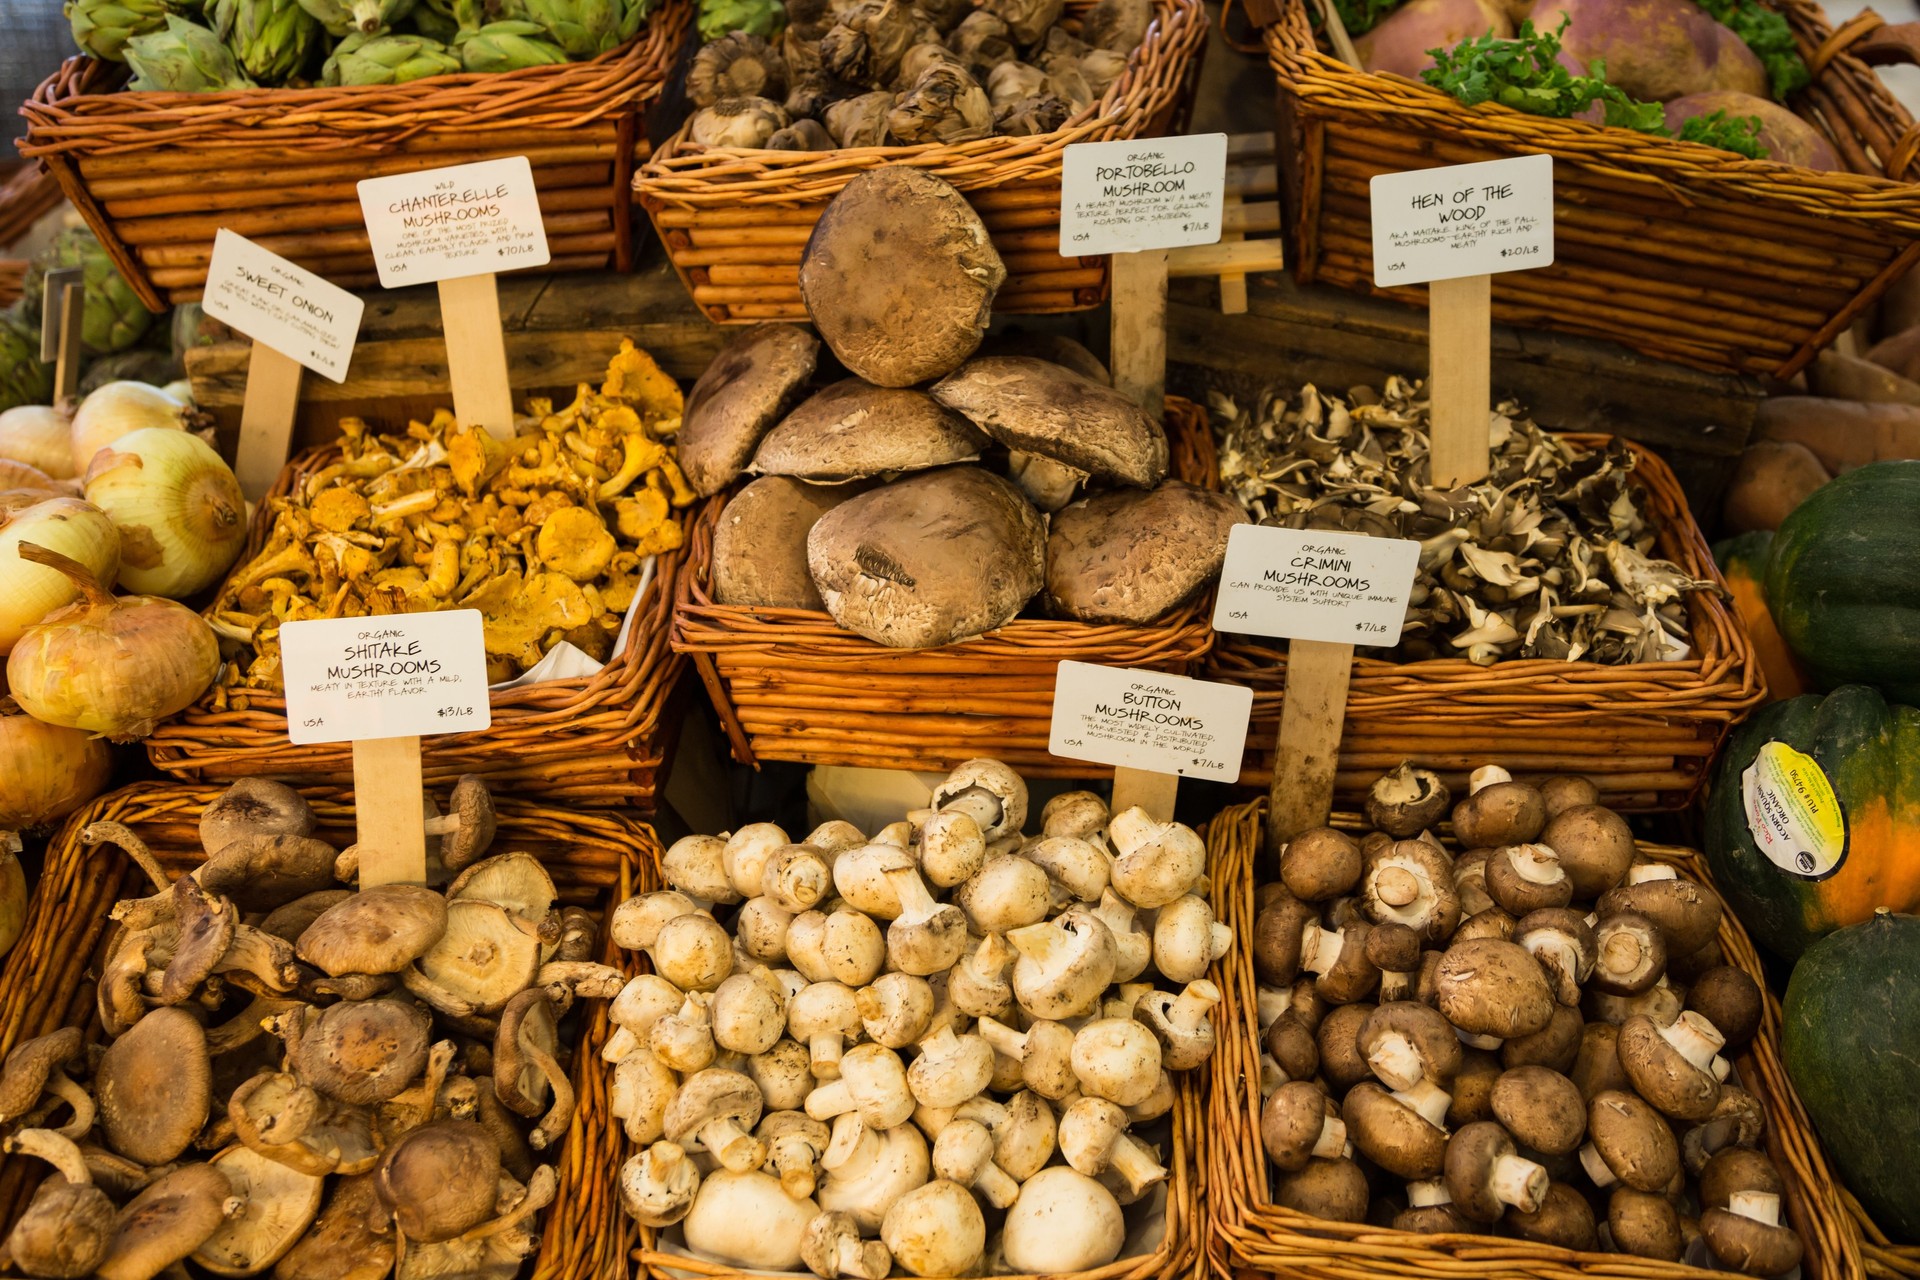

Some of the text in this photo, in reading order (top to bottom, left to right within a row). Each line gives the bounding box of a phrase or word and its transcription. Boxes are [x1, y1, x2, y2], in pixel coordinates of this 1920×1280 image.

[1127, 152, 1165, 162] ORGANIC
[1096, 162, 1195, 181] PORTOBELLO
[435, 181, 455, 191] WILD
[1103, 179, 1185, 197] MUSHROOM
[389, 184, 509, 214] CHANTERELLE
[1086, 200, 1116, 209] HEARTY
[1119, 197, 1161, 206] MUSHROOM
[1189, 192, 1213, 200] MEATY
[1411, 184, 1514, 209] HEN OF THE
[403, 203, 501, 228] MUSHROOMS
[1076, 210, 1111, 218] TEXTURE
[1115, 206, 1150, 215] PERFECT
[1439, 205, 1486, 223] WOOD
[402, 218, 509, 239] ONE OF THE MOST PRIZED
[1182, 222, 1210, 232] $7/LB
[1389, 232, 1408, 240] AKA
[1413, 227, 1450, 236] MAITAKE
[1456, 223, 1476, 231] KING
[1514, 216, 1538, 224] FALL
[1491, 226, 1512, 235] RICH
[1516, 224, 1533, 232] AND
[396, 237, 441, 249] MUSHROOM
[491, 226, 508, 234] WITH
[459, 238, 491, 248] FLAVOR
[496, 234, 512, 243] AND
[515, 231, 534, 240] FIRM
[1073, 233, 1090, 241] USA
[1450, 240, 1478, 249] MEATY
[444, 249, 480, 259] TEXTURE
[498, 246, 534, 257] $70/LB
[1500, 246, 1539, 257] $20/LB
[390, 263, 407, 272] USA
[1388, 262, 1406, 271] USA
[270, 266, 306, 288] ORGANIC
[236, 266, 333, 324] SWEET ONION
[1302, 545, 1346, 555] ORGANIC
[1291, 557, 1352, 572] CRIMINI
[1263, 570, 1370, 591] MUSHROOMS
[1229, 581, 1250, 589] CAN
[1253, 583, 1289, 593] PROVIDE
[1310, 589, 1328, 597] WITH
[1332, 592, 1363, 600] UNIQUE
[1367, 595, 1398, 603] IMMUNE
[1276, 594, 1350, 607] SYSTEM SUPPORT
[1229, 611, 1249, 619] USA
[358, 630, 405, 640] ORGANIC
[1355, 622, 1387, 633] $7/LB
[344, 640, 422, 661] SHITAKE
[327, 659, 442, 680] MUSHROOMS
[310, 682, 341, 692] MEATY
[358, 679, 398, 689] TEXTURE
[403, 677, 422, 685] WITH
[428, 676, 434, 684] A
[1131, 683, 1177, 696] ORGANIC
[347, 686, 428, 700] EARTHY FLAVOR
[1123, 692, 1182, 711] BUTTON
[437, 706, 474, 718] $13/LB
[1095, 704, 1204, 730] MUSHROOMS
[303, 717, 325, 727] USA
[1080, 714, 1097, 722] THE
[1101, 717, 1124, 727] MOST
[1128, 722, 1160, 733] WIDELY
[1064, 739, 1083, 747] USA
[1086, 731, 1136, 743] MUSHROOM
[1152, 741, 1168, 749] THE
[1173, 744, 1205, 754] WORLD
[1087, 723, 1139, 737] HARVESTED
[1156, 734, 1208, 748] DISTRIBUTED
[1192, 758, 1224, 770] $7/LB
[1790, 769, 1807, 794] 94750
[1757, 784, 1771, 814] SQUASH
[1766, 789, 1790, 825] ORGANIC
[1806, 798, 1819, 814] PLU
[1770, 814, 1792, 840] ACORN
